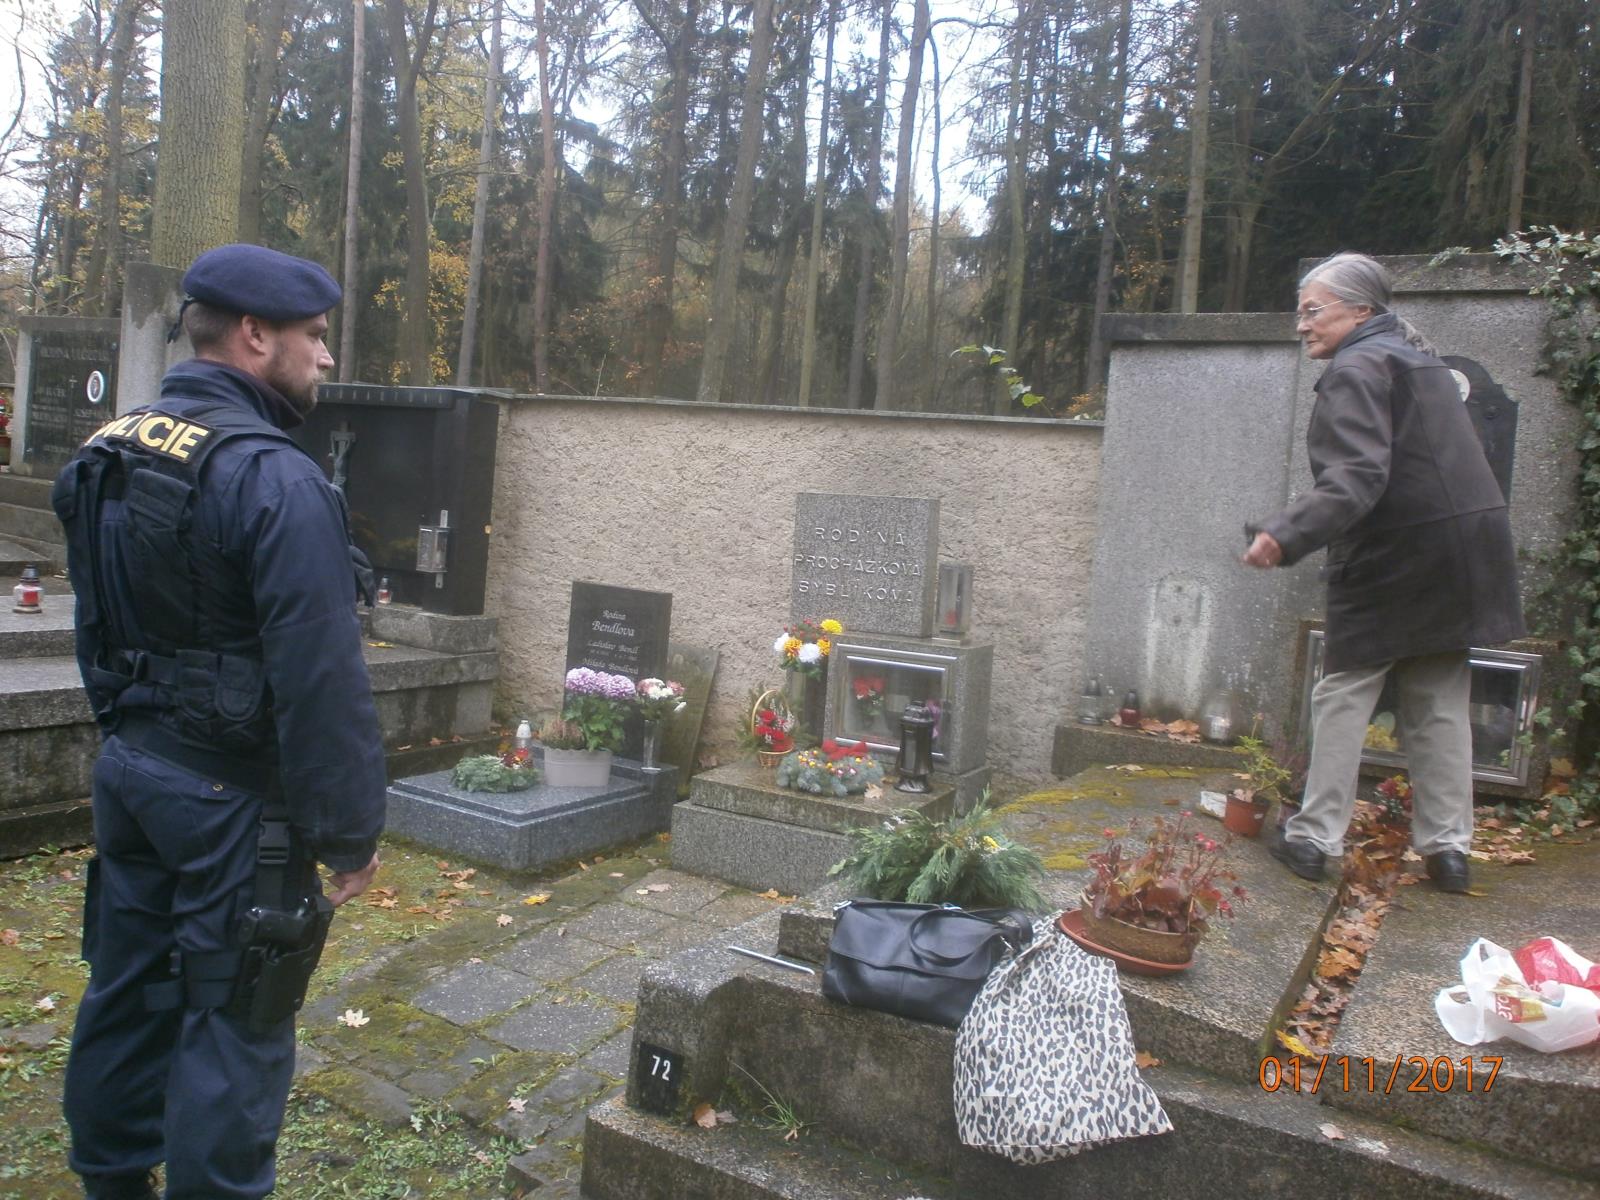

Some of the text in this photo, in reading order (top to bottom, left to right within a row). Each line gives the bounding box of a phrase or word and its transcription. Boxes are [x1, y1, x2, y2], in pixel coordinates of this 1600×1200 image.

[84, 412, 209, 460] LICIE
[814, 527, 905, 546] RODINA
[591, 620, 635, 637] Bendlova
[652, 1054, 671, 1081] 72
